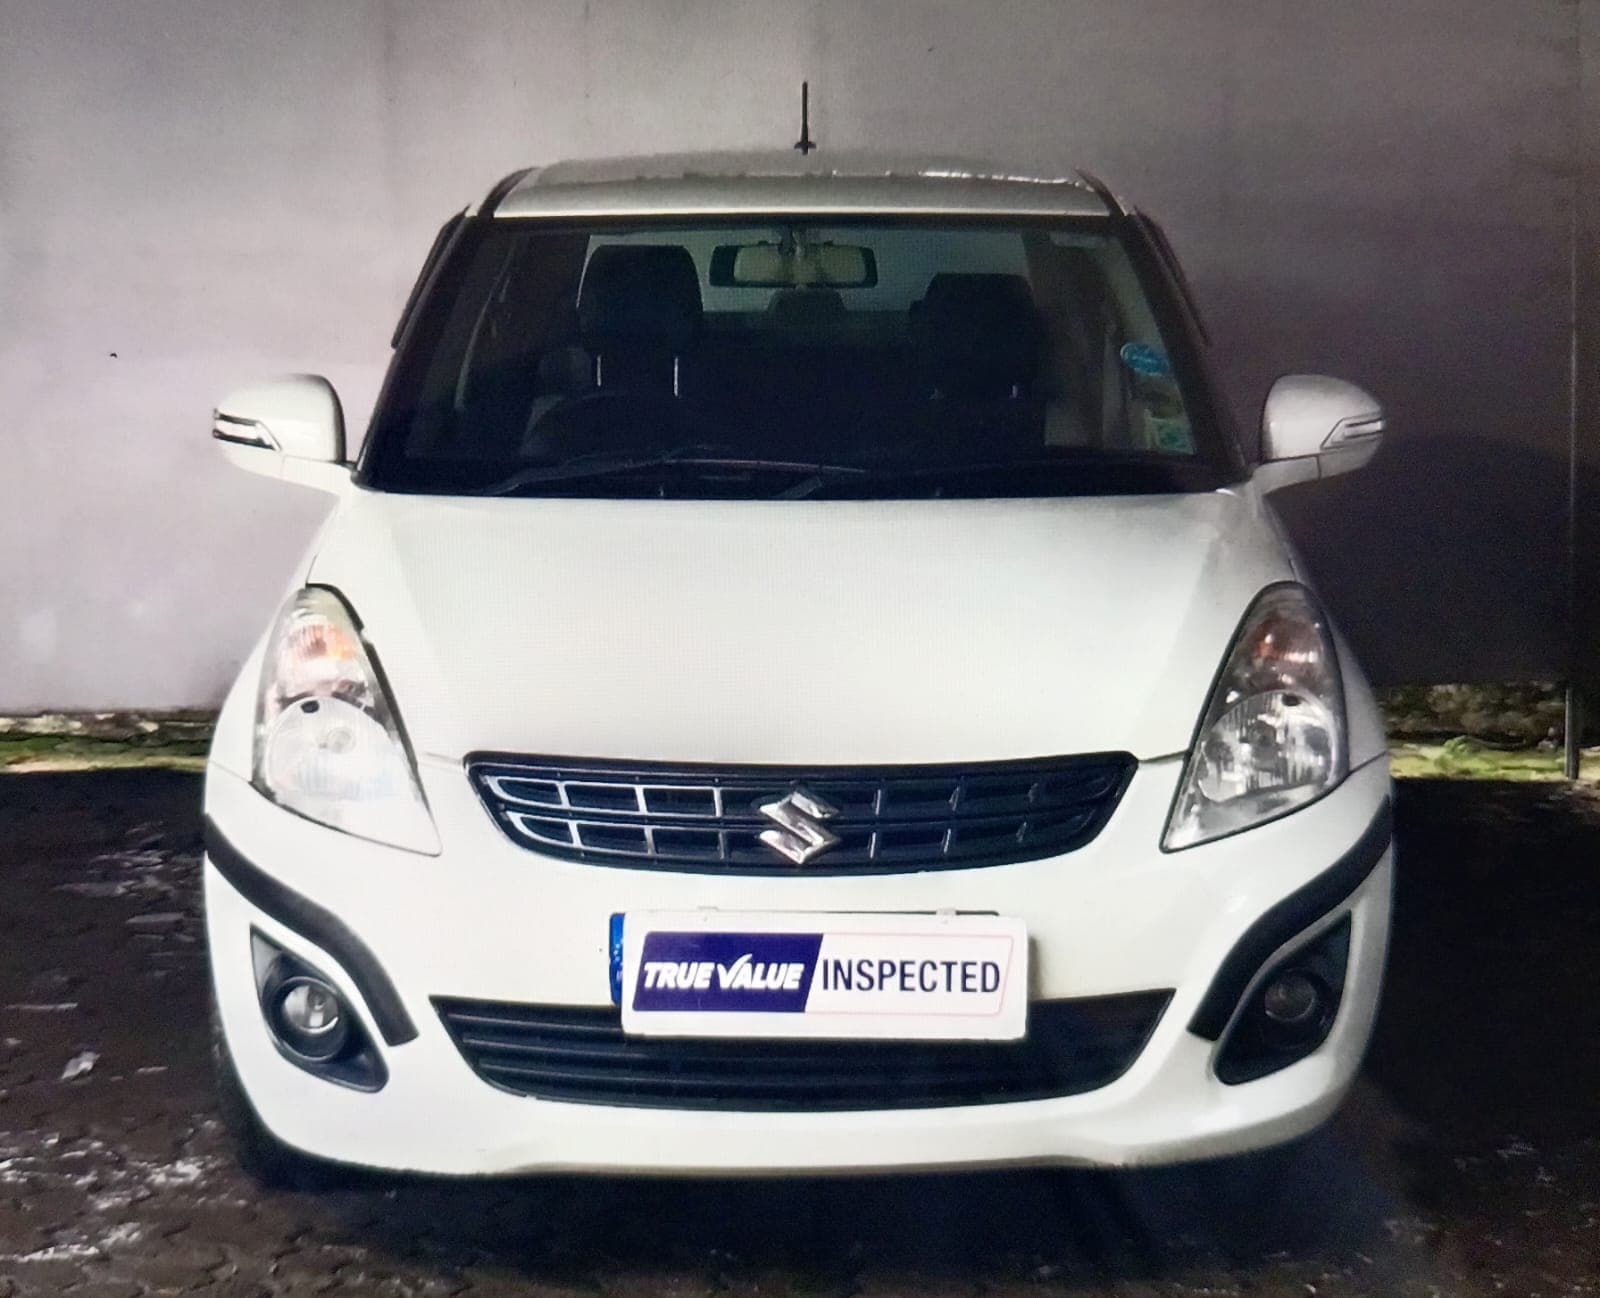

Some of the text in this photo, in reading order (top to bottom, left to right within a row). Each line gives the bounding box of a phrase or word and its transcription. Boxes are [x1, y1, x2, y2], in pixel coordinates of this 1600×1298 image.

[643, 954, 1000, 992] TRUE VALUE INSPECTED
